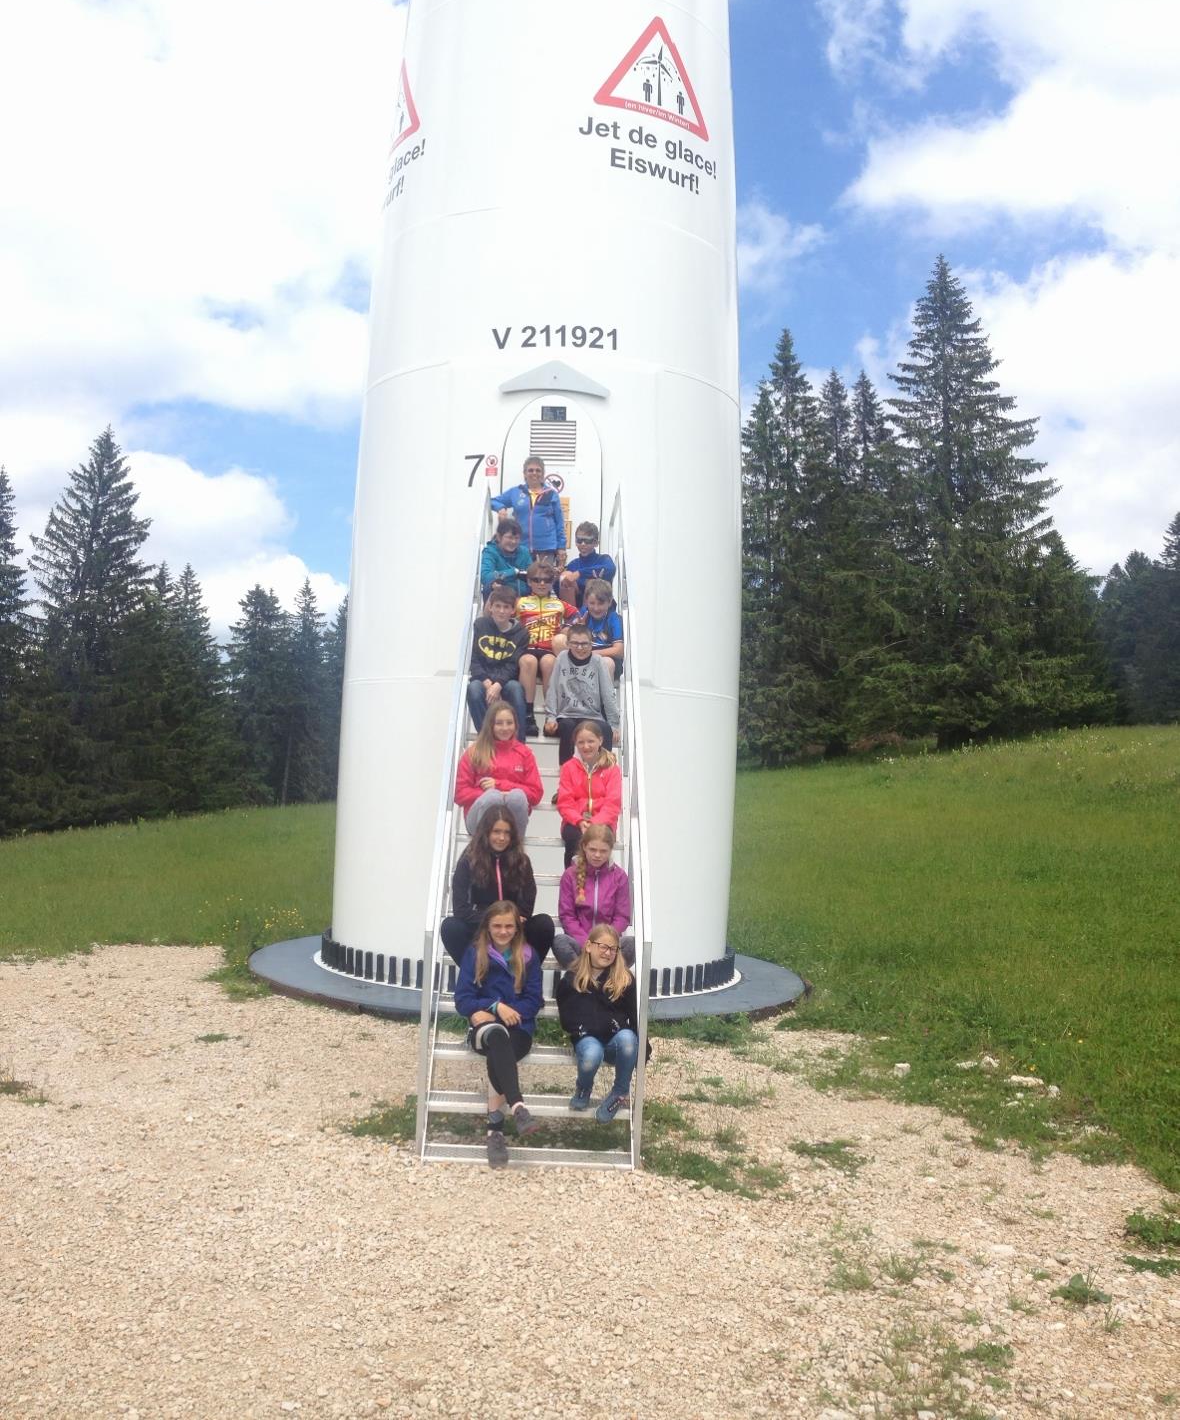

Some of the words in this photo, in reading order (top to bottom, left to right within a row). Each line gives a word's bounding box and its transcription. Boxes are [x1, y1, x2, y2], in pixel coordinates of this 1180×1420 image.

[578, 116, 621, 141] Jet
[628, 126, 658, 149] de
[665, 140, 717, 180] glace!
[610, 147, 700, 195] Eiswurf!
[491, 327, 512, 350] V
[520, 324, 618, 351] 211921
[464, 454, 485, 488] 7
[561, 667, 596, 681] FRESH
